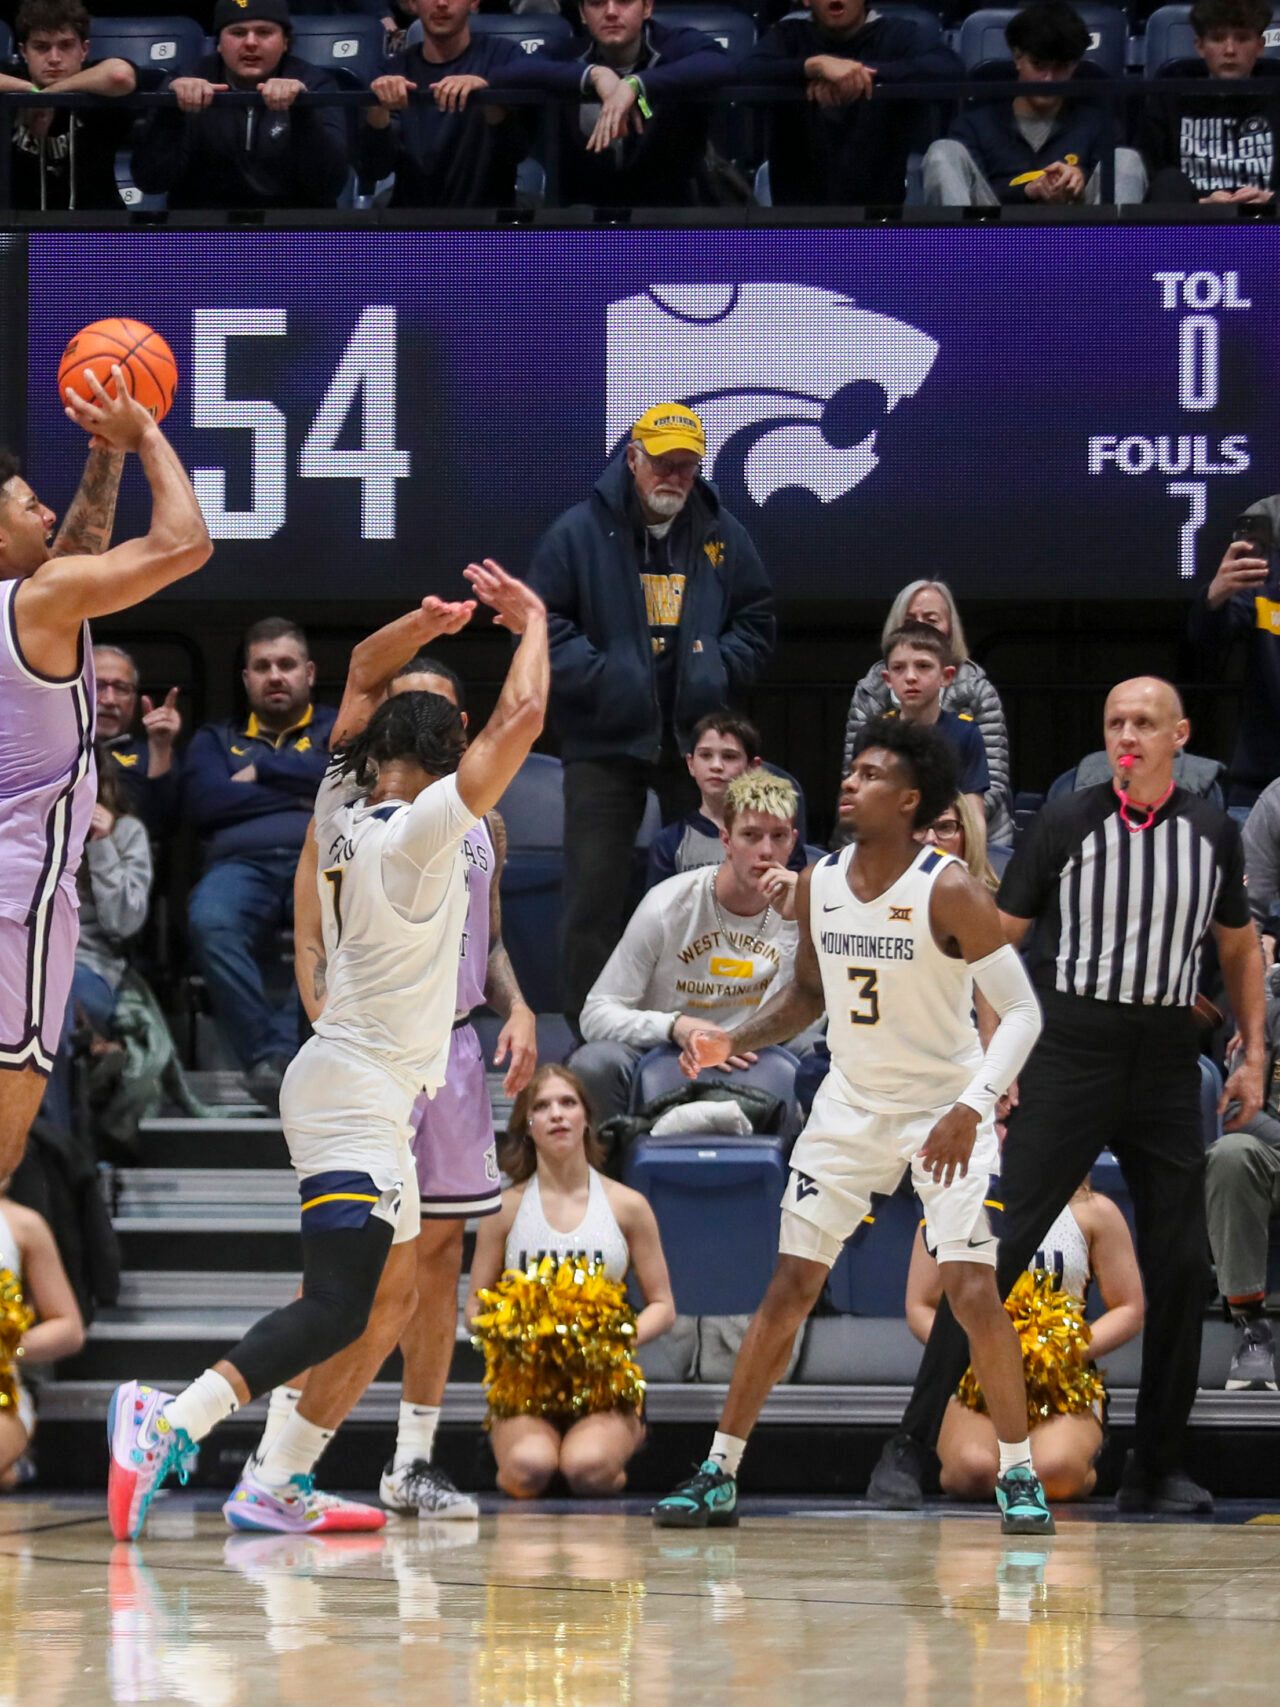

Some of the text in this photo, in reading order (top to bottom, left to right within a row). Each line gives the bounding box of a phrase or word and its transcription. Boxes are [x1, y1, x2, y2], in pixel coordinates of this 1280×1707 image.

[1152, 271, 1252, 311] TOL
[1178, 315, 1219, 412] 0
[191, 305, 411, 539] 54
[1087, 434, 1251, 475] FOULS
[1166, 481, 1208, 579] 7
[677, 931, 721, 965] WEST
[820, 931, 914, 961] MOUNTAINEERS
[847, 966, 880, 1025] 3
